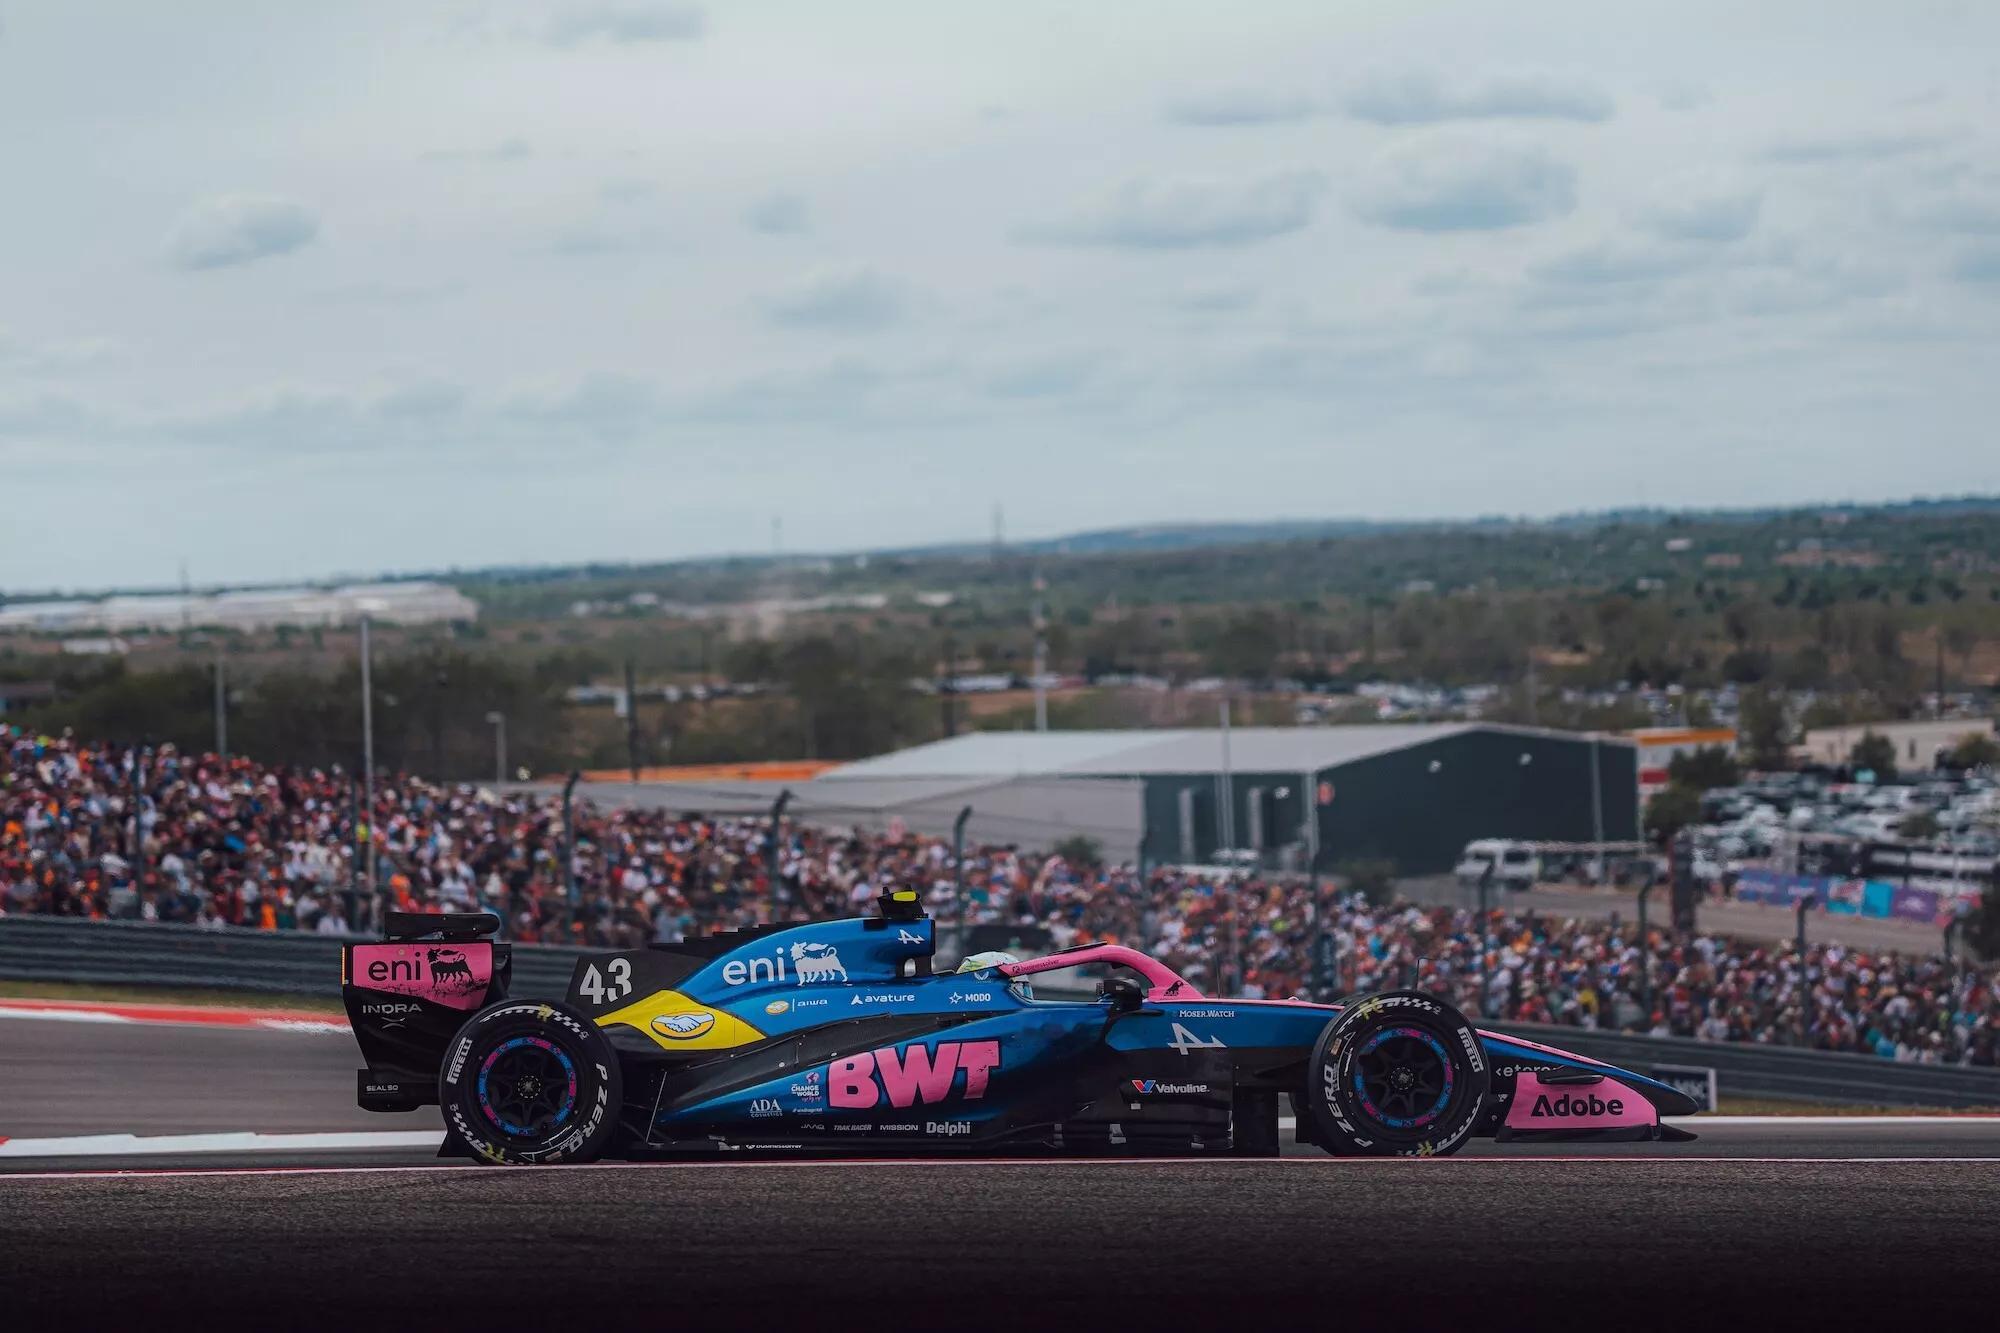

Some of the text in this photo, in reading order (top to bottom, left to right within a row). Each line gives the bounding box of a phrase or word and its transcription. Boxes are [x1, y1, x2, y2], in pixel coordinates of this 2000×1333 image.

[368, 952, 421, 981] eni
[579, 958, 632, 1004] 43
[722, 947, 784, 985] eni
[362, 1003, 423, 1014] INDRA
[865, 993, 915, 1003] avature
[965, 993, 991, 1002] MODO
[447, 1037, 473, 1084] PIRELLI
[1457, 1026, 1484, 1073] PIRELLI
[829, 1040, 999, 1108] BWT
[568, 1063, 609, 1153] P ZERO
[750, 1098, 781, 1112] ADA
[1323, 1064, 1374, 1148] P ZERO
[1531, 1094, 1624, 1117] Adobe
[926, 1121, 971, 1136] Delphi
